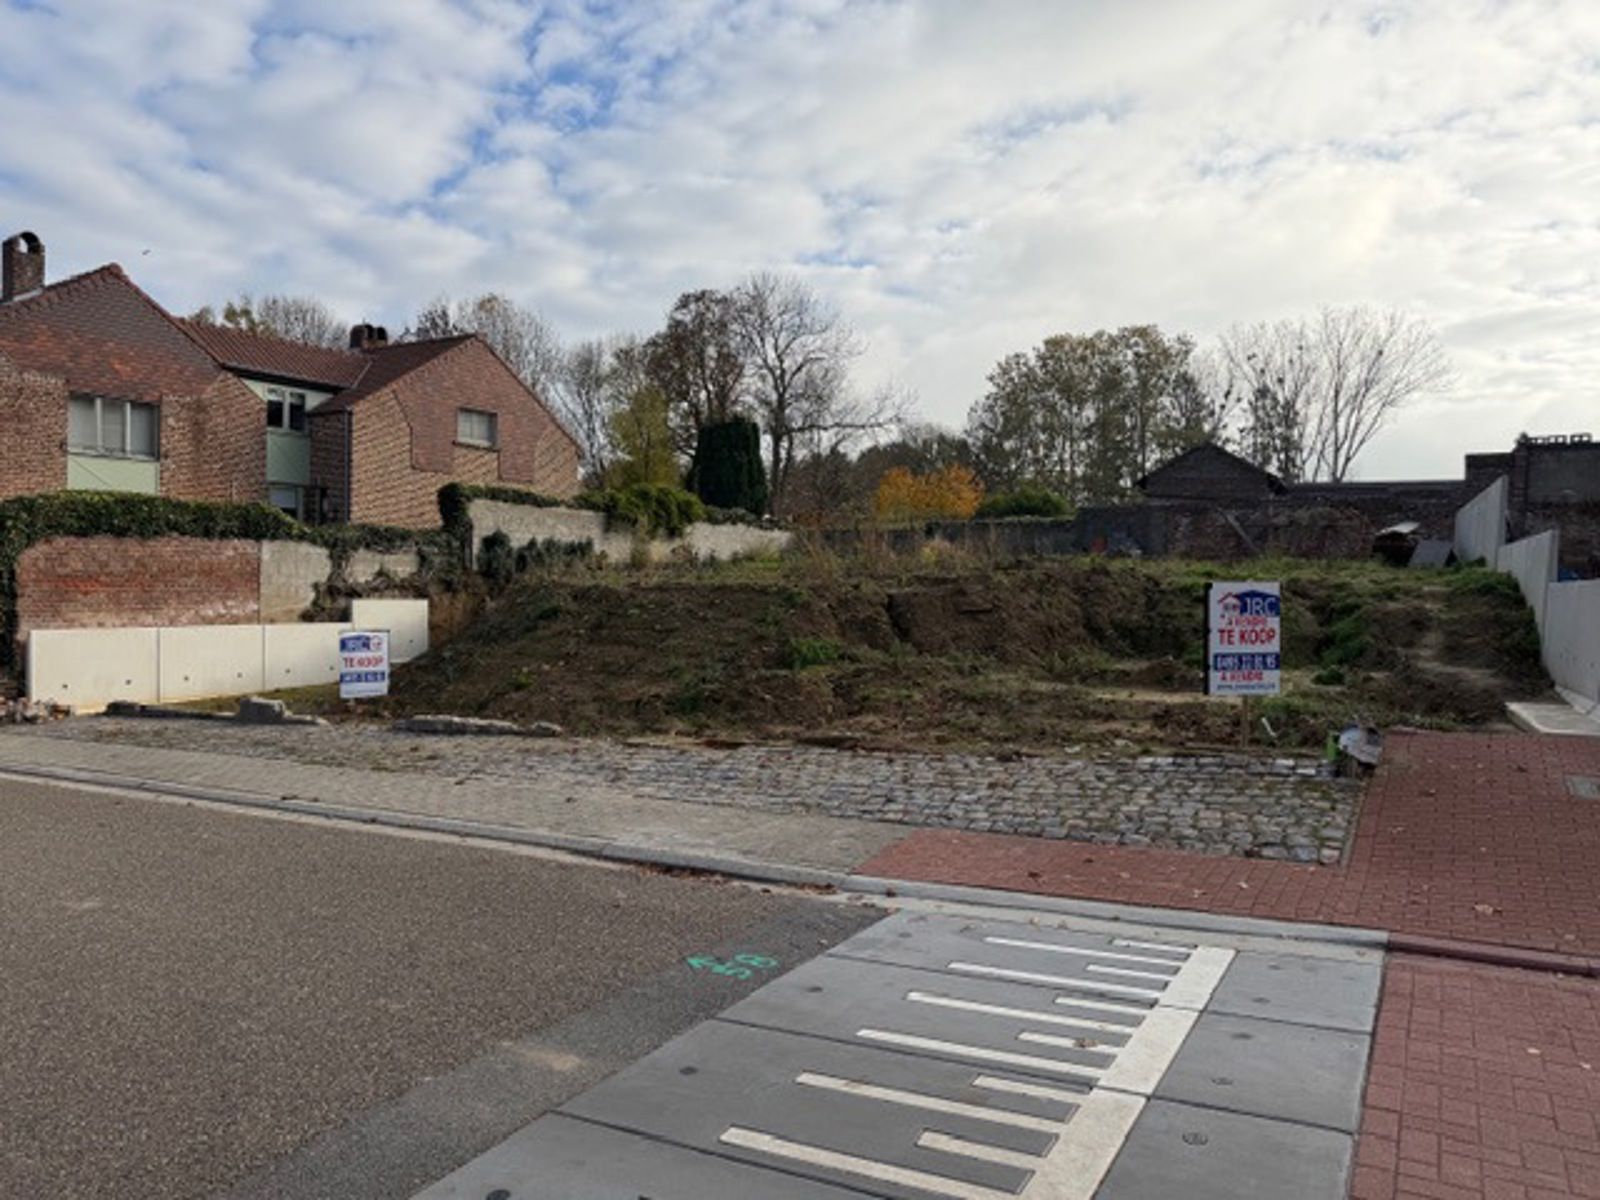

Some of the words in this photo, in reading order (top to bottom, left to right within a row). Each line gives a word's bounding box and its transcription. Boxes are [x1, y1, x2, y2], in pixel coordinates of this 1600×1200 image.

[1246, 597, 1277, 615] JRC
[1218, 629, 1235, 646] TE
[1239, 628, 1276, 646] KOOP
[343, 657, 355, 669] TE
[357, 656, 384, 669] KOOP
